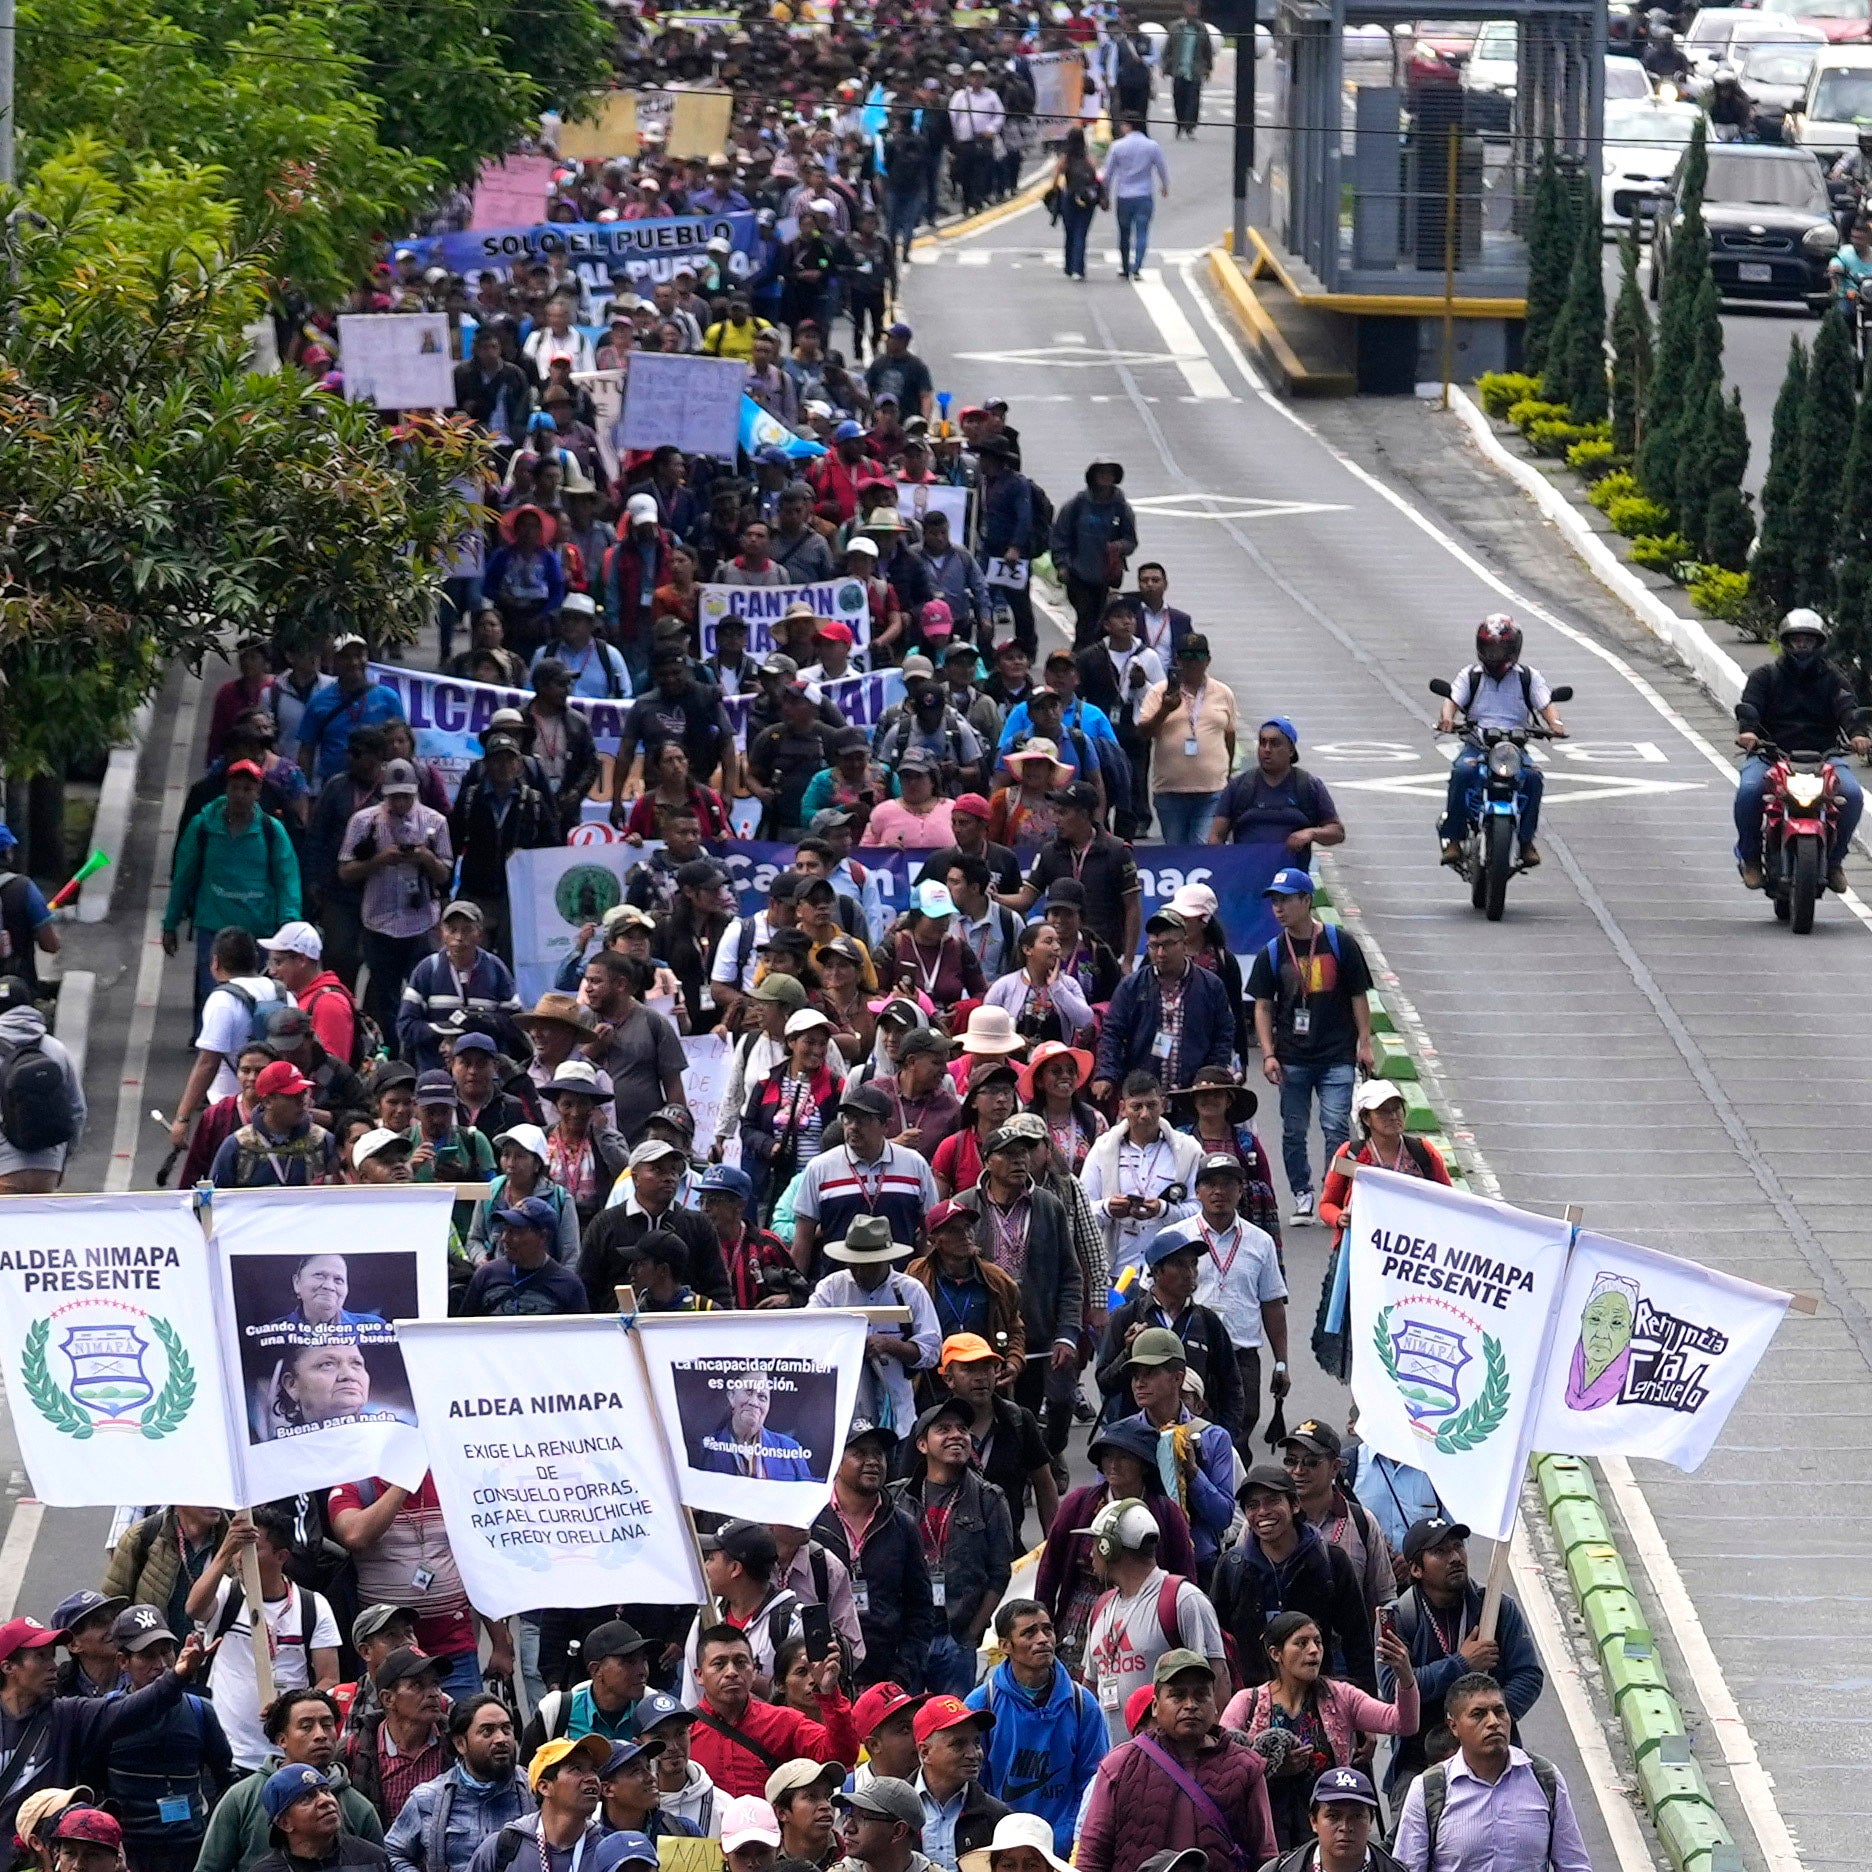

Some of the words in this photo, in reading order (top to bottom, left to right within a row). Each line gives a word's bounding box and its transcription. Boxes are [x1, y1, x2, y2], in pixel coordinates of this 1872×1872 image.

[483, 233, 559, 257] SOLO
[568, 233, 608, 255] EL
[616, 221, 734, 252] PUEBLO
[0, 1248, 77, 1270] ALDEA
[86, 1246, 180, 1267] NIMAPA
[1371, 1228, 1438, 1266] ALDEA
[1444, 1247, 1534, 1293] NIMAPA
[25, 1270, 161, 1292] PRESENTE
[1381, 1257, 1512, 1310] PRESENTE
[246, 1321, 296, 1336] Cuando
[299, 1323, 313, 1333] te
[315, 1322, 353, 1333] dicen
[356, 1322, 381, 1333] que
[260, 1336, 285, 1347] una
[288, 1333, 324, 1346] fiscal
[327, 1334, 357, 1348] muy
[708, 1378, 724, 1389] es
[449, 1397, 524, 1418] ALDEA
[531, 1392, 623, 1414] NIMAPA
[276, 1420, 321, 1438] Buena
[323, 1414, 357, 1429] para
[359, 1411, 396, 1423] nada
[464, 1443, 510, 1459] EXIGE
[513, 1442, 535, 1458] LA
[538, 1436, 623, 1457] RENUNCIA
[536, 1466, 558, 1480] DE
[473, 1484, 561, 1505] CONSUELO
[472, 1508, 531, 1528] RAFAEL
[538, 1500, 653, 1523] CURRUCHICHE
[486, 1535, 497, 1550] Y
[557, 1525, 651, 1545] ORELLANA.
[1009, 1749, 1051, 1778] NIKE
[1336, 1771, 1357, 1787] LA
